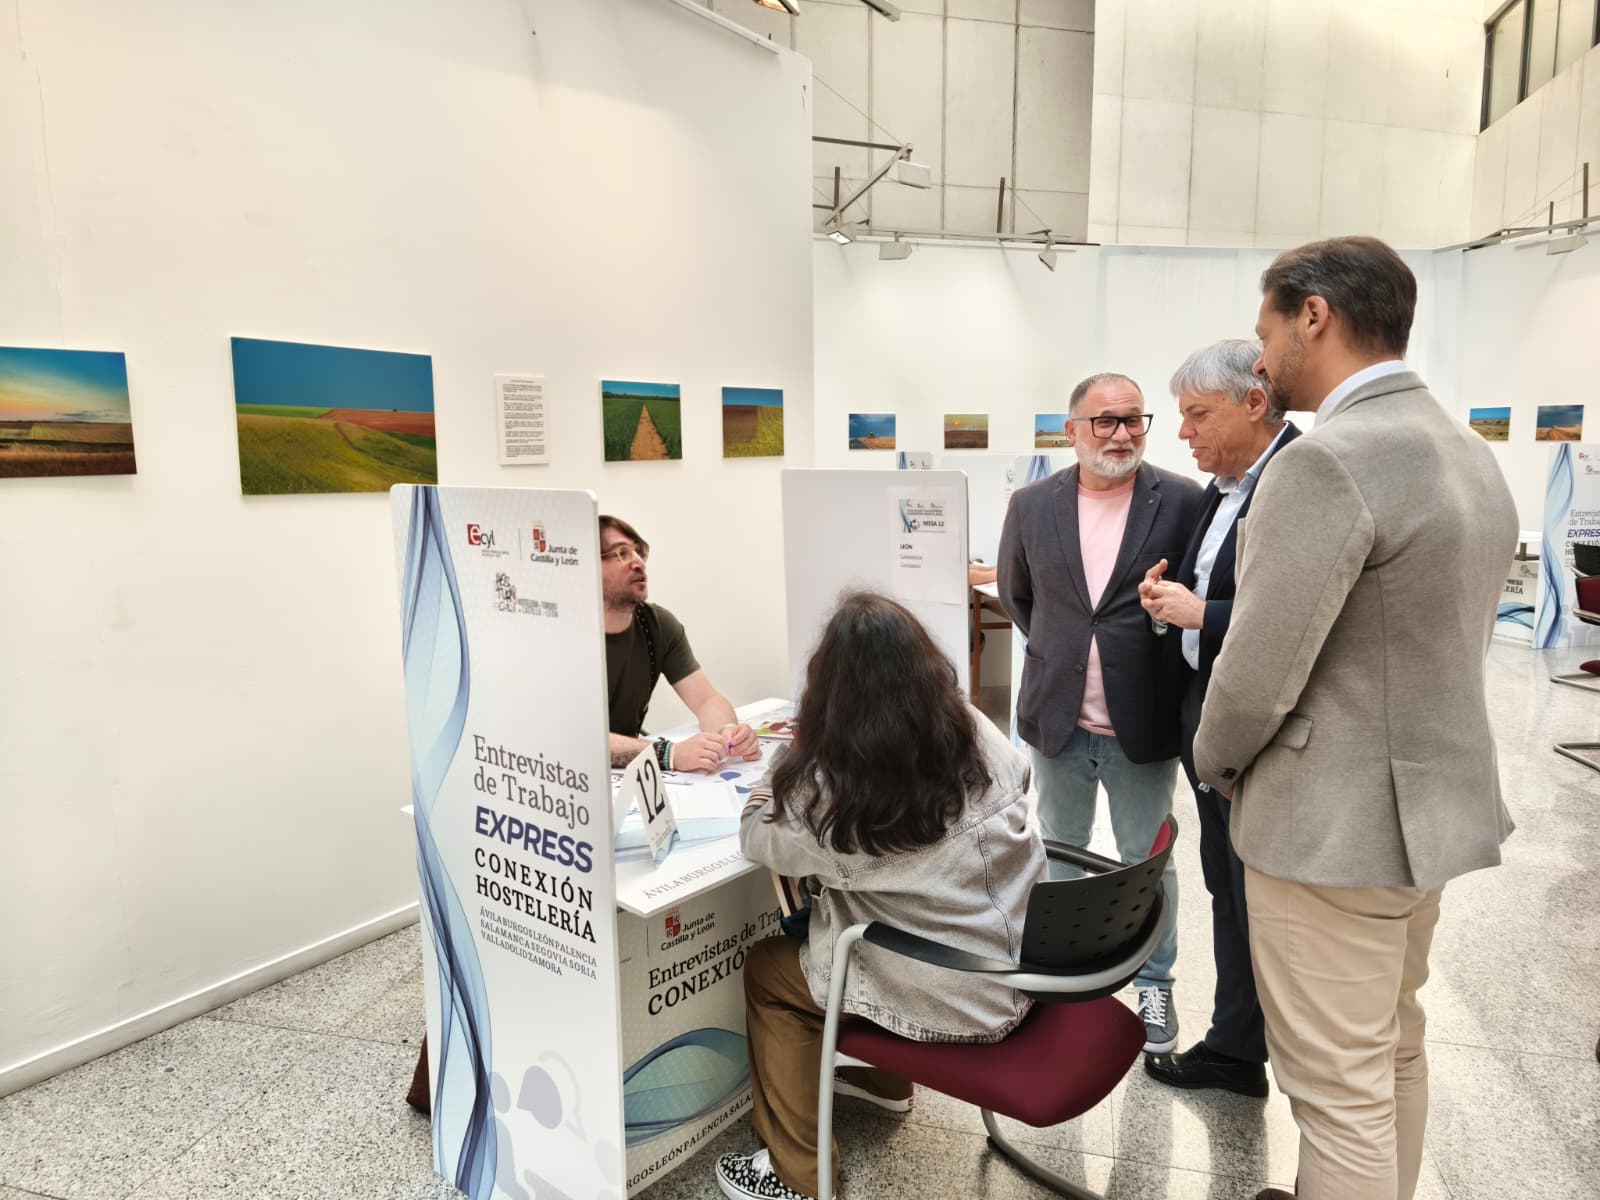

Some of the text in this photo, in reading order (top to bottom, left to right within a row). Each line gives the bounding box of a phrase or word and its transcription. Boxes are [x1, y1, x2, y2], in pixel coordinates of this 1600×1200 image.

[530, 553, 555, 564] Castilla
[561, 555, 579, 567] León
[548, 544, 578, 555] Junta de
[1503, 585, 1524, 595] ERÍA
[473, 734, 590, 793] Entrevistas
[636, 759, 666, 824] 12
[474, 765, 590, 830] de Trabajo
[475, 805, 594, 874] EXPRESS
[475, 847, 593, 912] CONEXIÓN
[475, 874, 597, 944] HOSTELERÍA
[648, 934, 738, 990] Entrevistas
[740, 922, 756, 942] de
[758, 906, 781, 930] Tra
[660, 934, 689, 951] Castilla
[696, 921, 715, 935] León
[682, 912, 715, 932] Junta de
[647, 945, 751, 1016] CONEXIÓ
